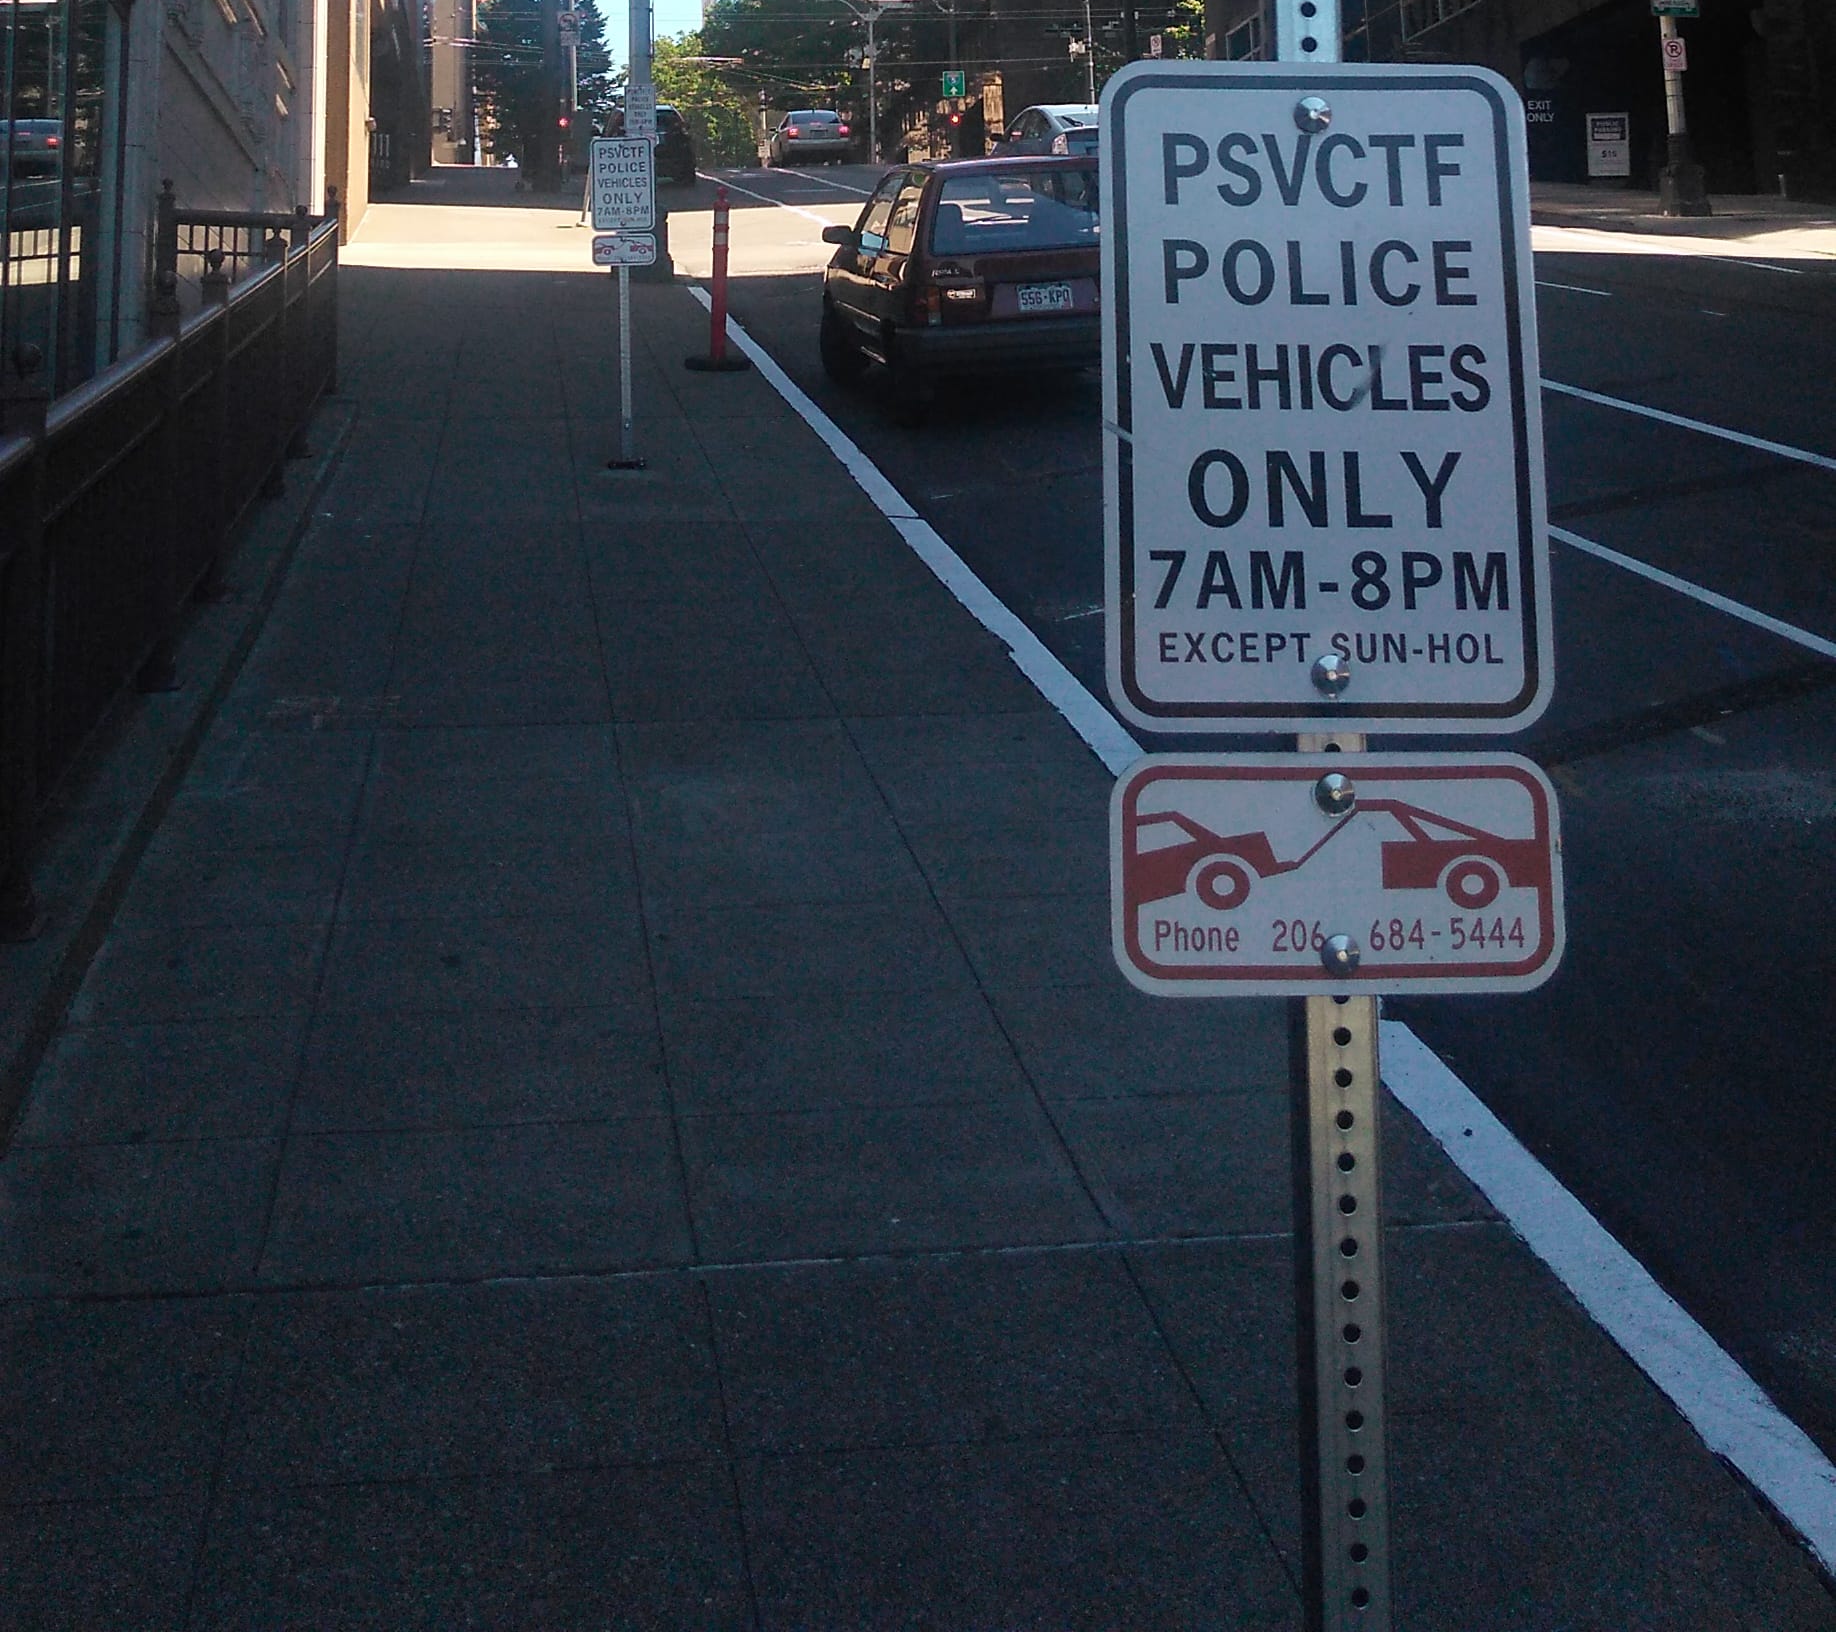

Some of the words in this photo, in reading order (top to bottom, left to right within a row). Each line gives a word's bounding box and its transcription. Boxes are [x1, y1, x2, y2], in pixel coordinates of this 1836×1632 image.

[1526, 112, 1554, 122] ONLY
[1527, 100, 1552, 110] EXIT
[599, 146, 644, 159] PSVCTF
[599, 161, 646, 173] POLICE
[597, 177, 647, 188] VEHICLES
[1162, 132, 1464, 207] PSVCTF
[602, 191, 642, 204] ONLY
[1163, 239, 1477, 306] POLICE
[1150, 342, 1490, 412] VEHICLES
[1187, 449, 1461, 528] ONLY
[1149, 550, 1510, 610] 7AM-8PM
[1159, 632, 1311, 664] EXCEPT
[1330, 632, 1504, 664] SUN-HOL
[1154, 919, 1240, 952] Phone
[1272, 919, 1324, 952] 206
[1370, 916, 1526, 950] 684-5444
